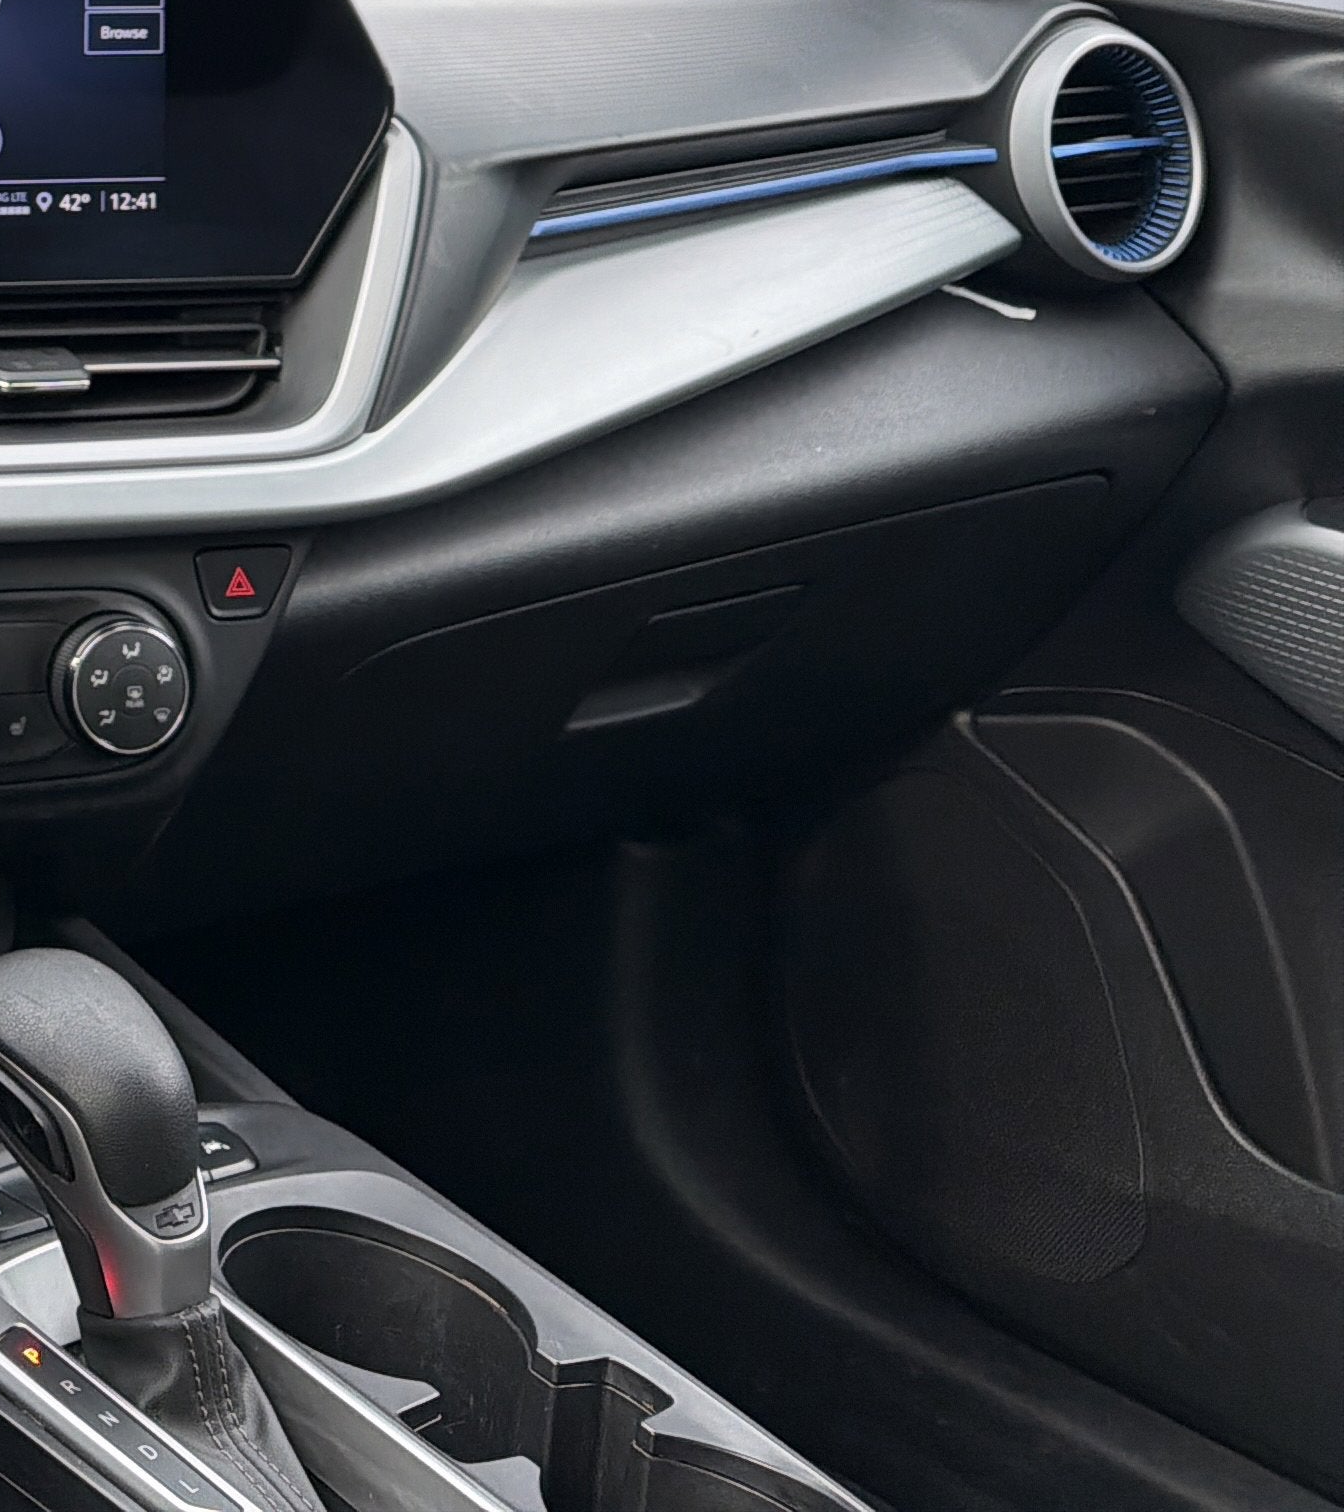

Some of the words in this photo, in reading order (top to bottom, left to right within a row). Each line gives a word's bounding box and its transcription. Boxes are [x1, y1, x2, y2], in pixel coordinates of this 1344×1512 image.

[100, 25, 148, 41] Browse
[110, 192, 158, 211] 12:41
[23, 1347, 41, 1365] P
[60, 1379, 81, 1395] R
[137, 1444, 159, 1461] D
